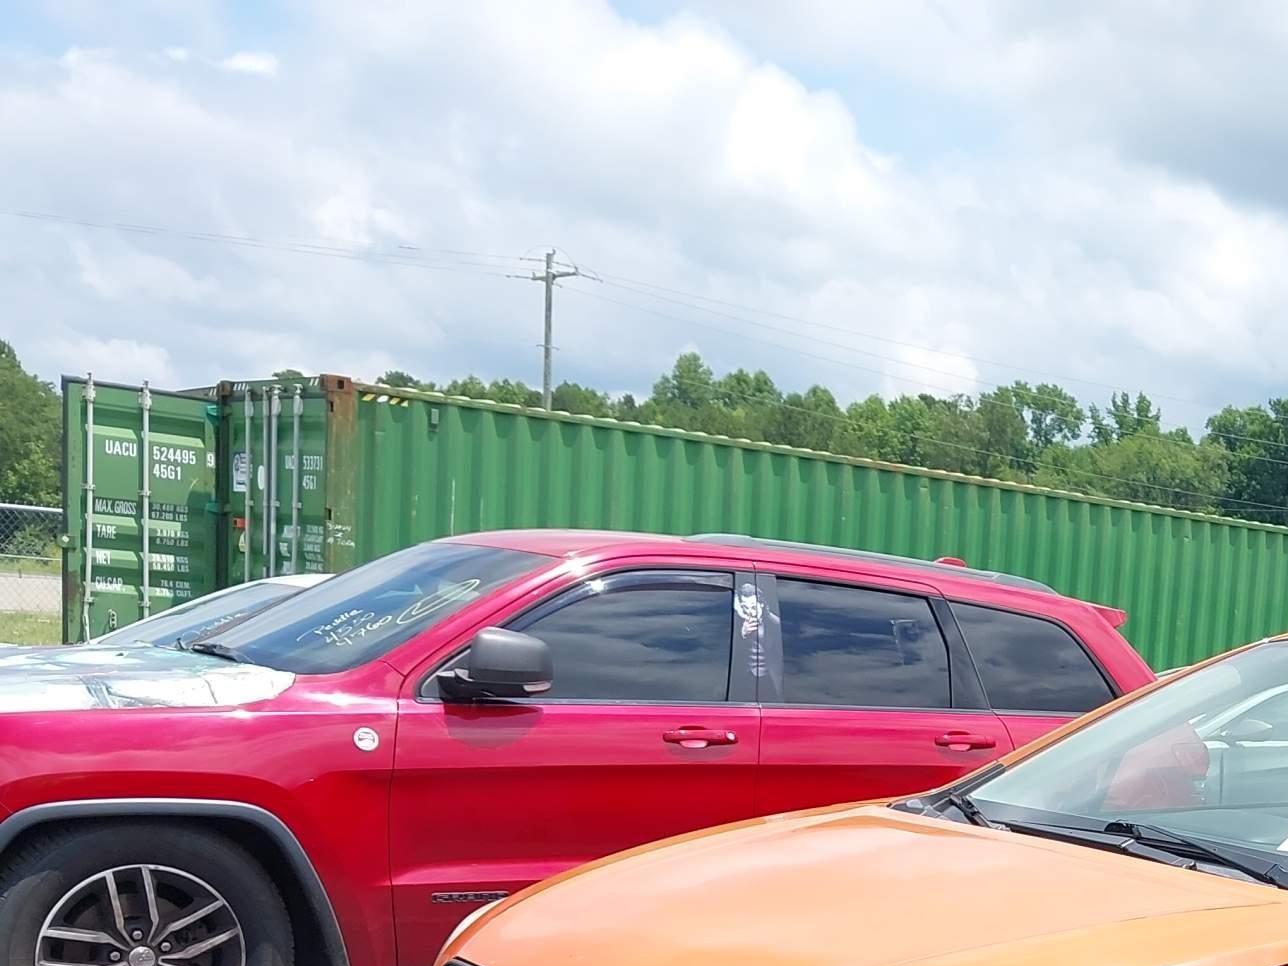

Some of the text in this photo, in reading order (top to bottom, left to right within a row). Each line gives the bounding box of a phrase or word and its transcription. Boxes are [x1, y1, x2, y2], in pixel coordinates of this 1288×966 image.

[105, 439, 216, 469] UACU 524495 9
[152, 463, 182, 480] 45G1
[96, 524, 117, 539] TARE
[95, 550, 112, 565] NET
